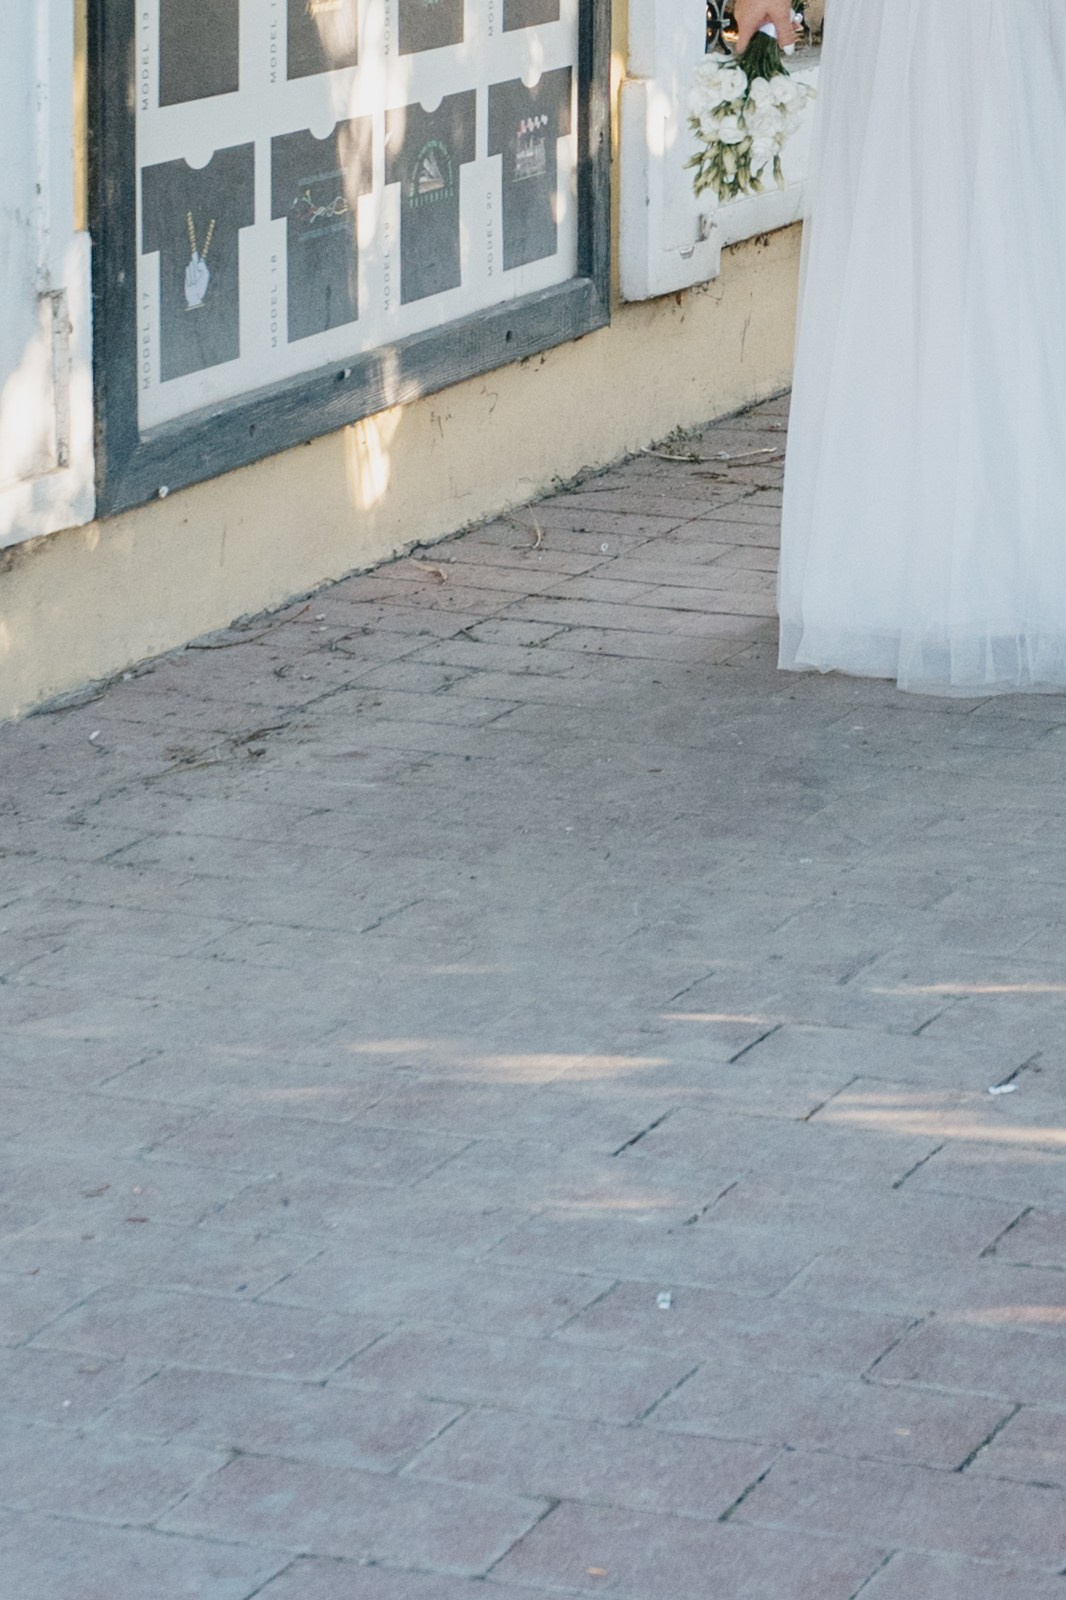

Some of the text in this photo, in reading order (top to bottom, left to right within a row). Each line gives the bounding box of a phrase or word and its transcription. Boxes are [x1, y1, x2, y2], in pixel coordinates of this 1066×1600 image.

[141, 42, 150, 112] MODEL
[269, 18, 278, 84] MODEL
[383, 248, 392, 312] MODEL
[485, 218, 494, 278] MODEL
[270, 283, 279, 349] MODEL
[141, 321, 151, 390] MODEL
